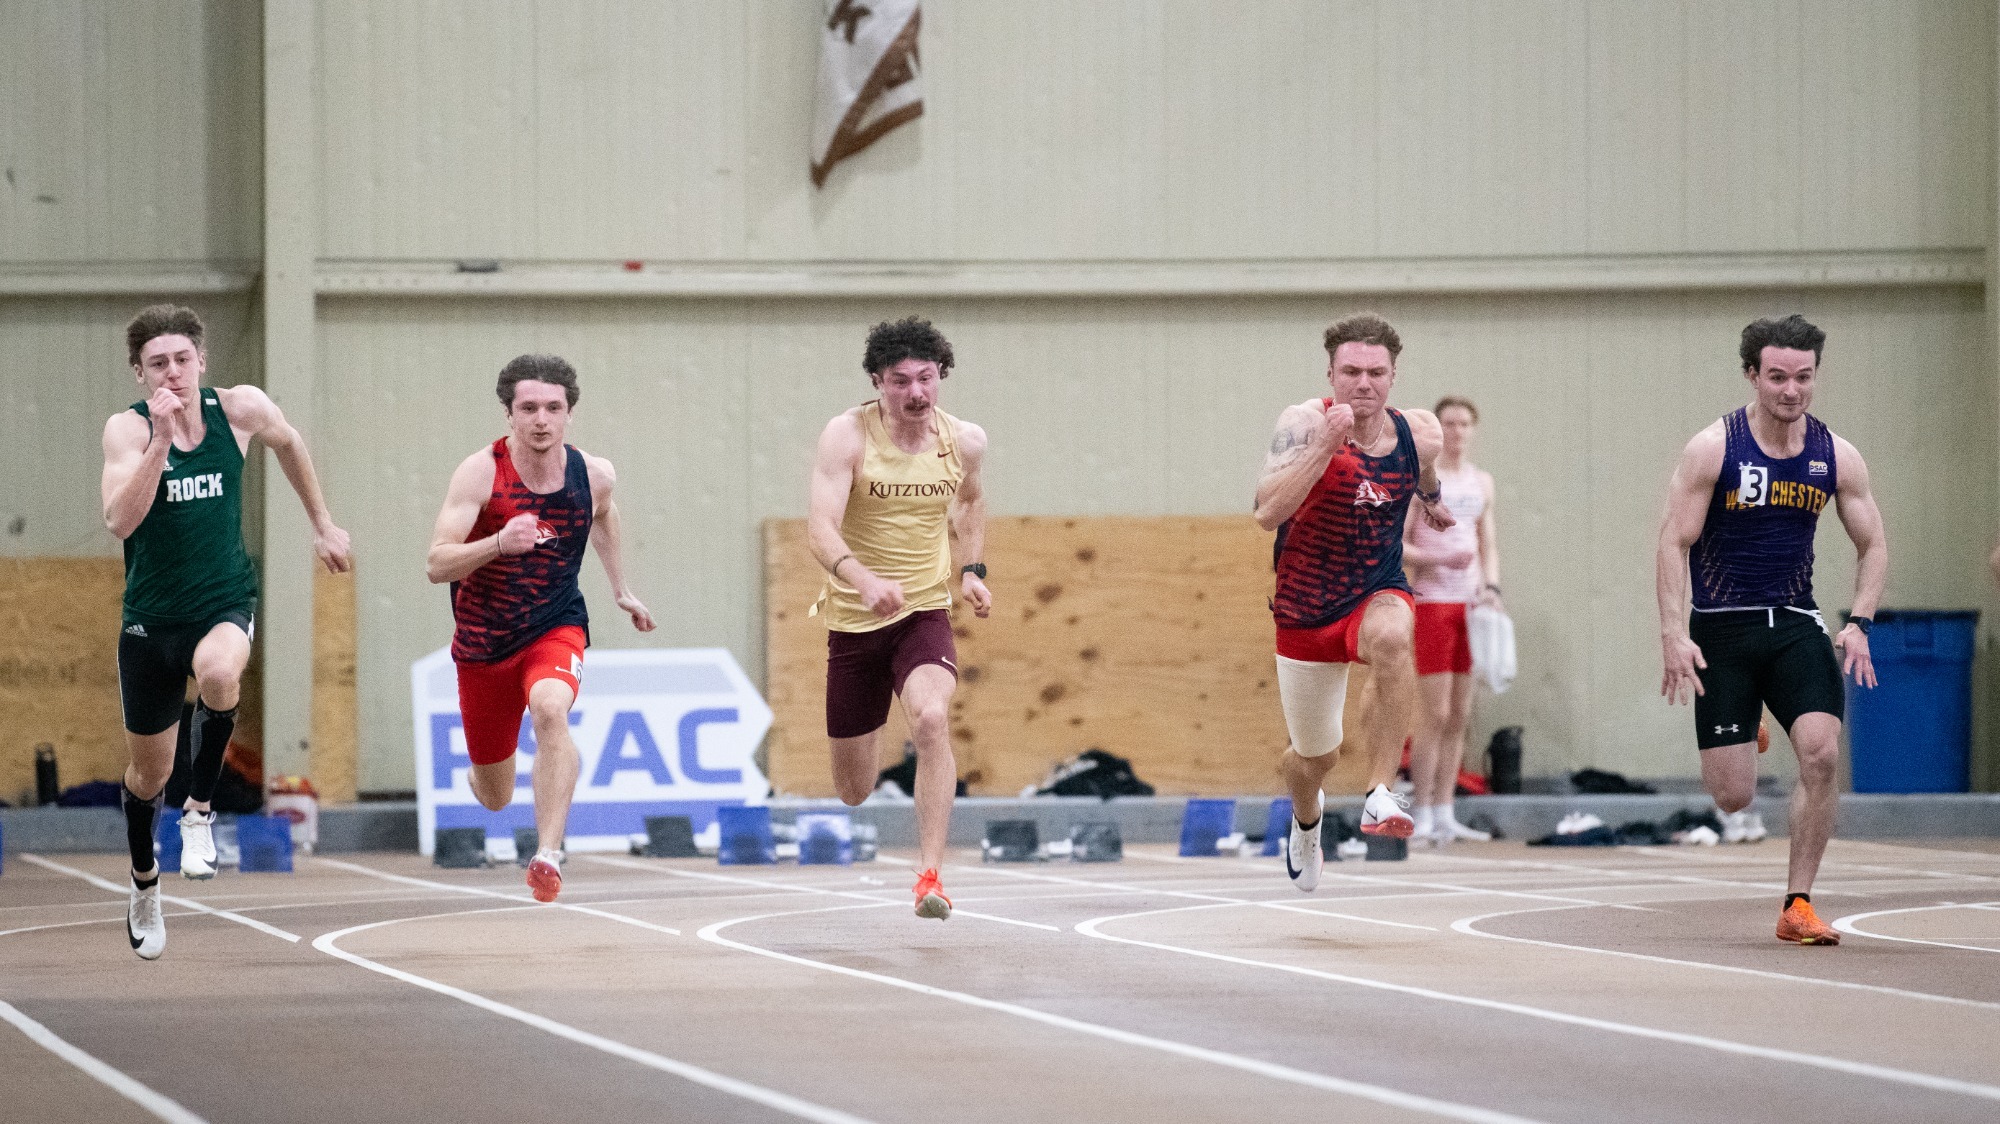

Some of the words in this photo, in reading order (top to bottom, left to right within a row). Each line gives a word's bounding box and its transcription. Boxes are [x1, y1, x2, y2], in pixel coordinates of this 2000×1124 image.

[167, 473, 223, 502] ROCK
[868, 480, 957, 498] KUTZTOWN
[1745, 469, 1764, 502] 3
[1771, 481, 1826, 513] CHESTER
